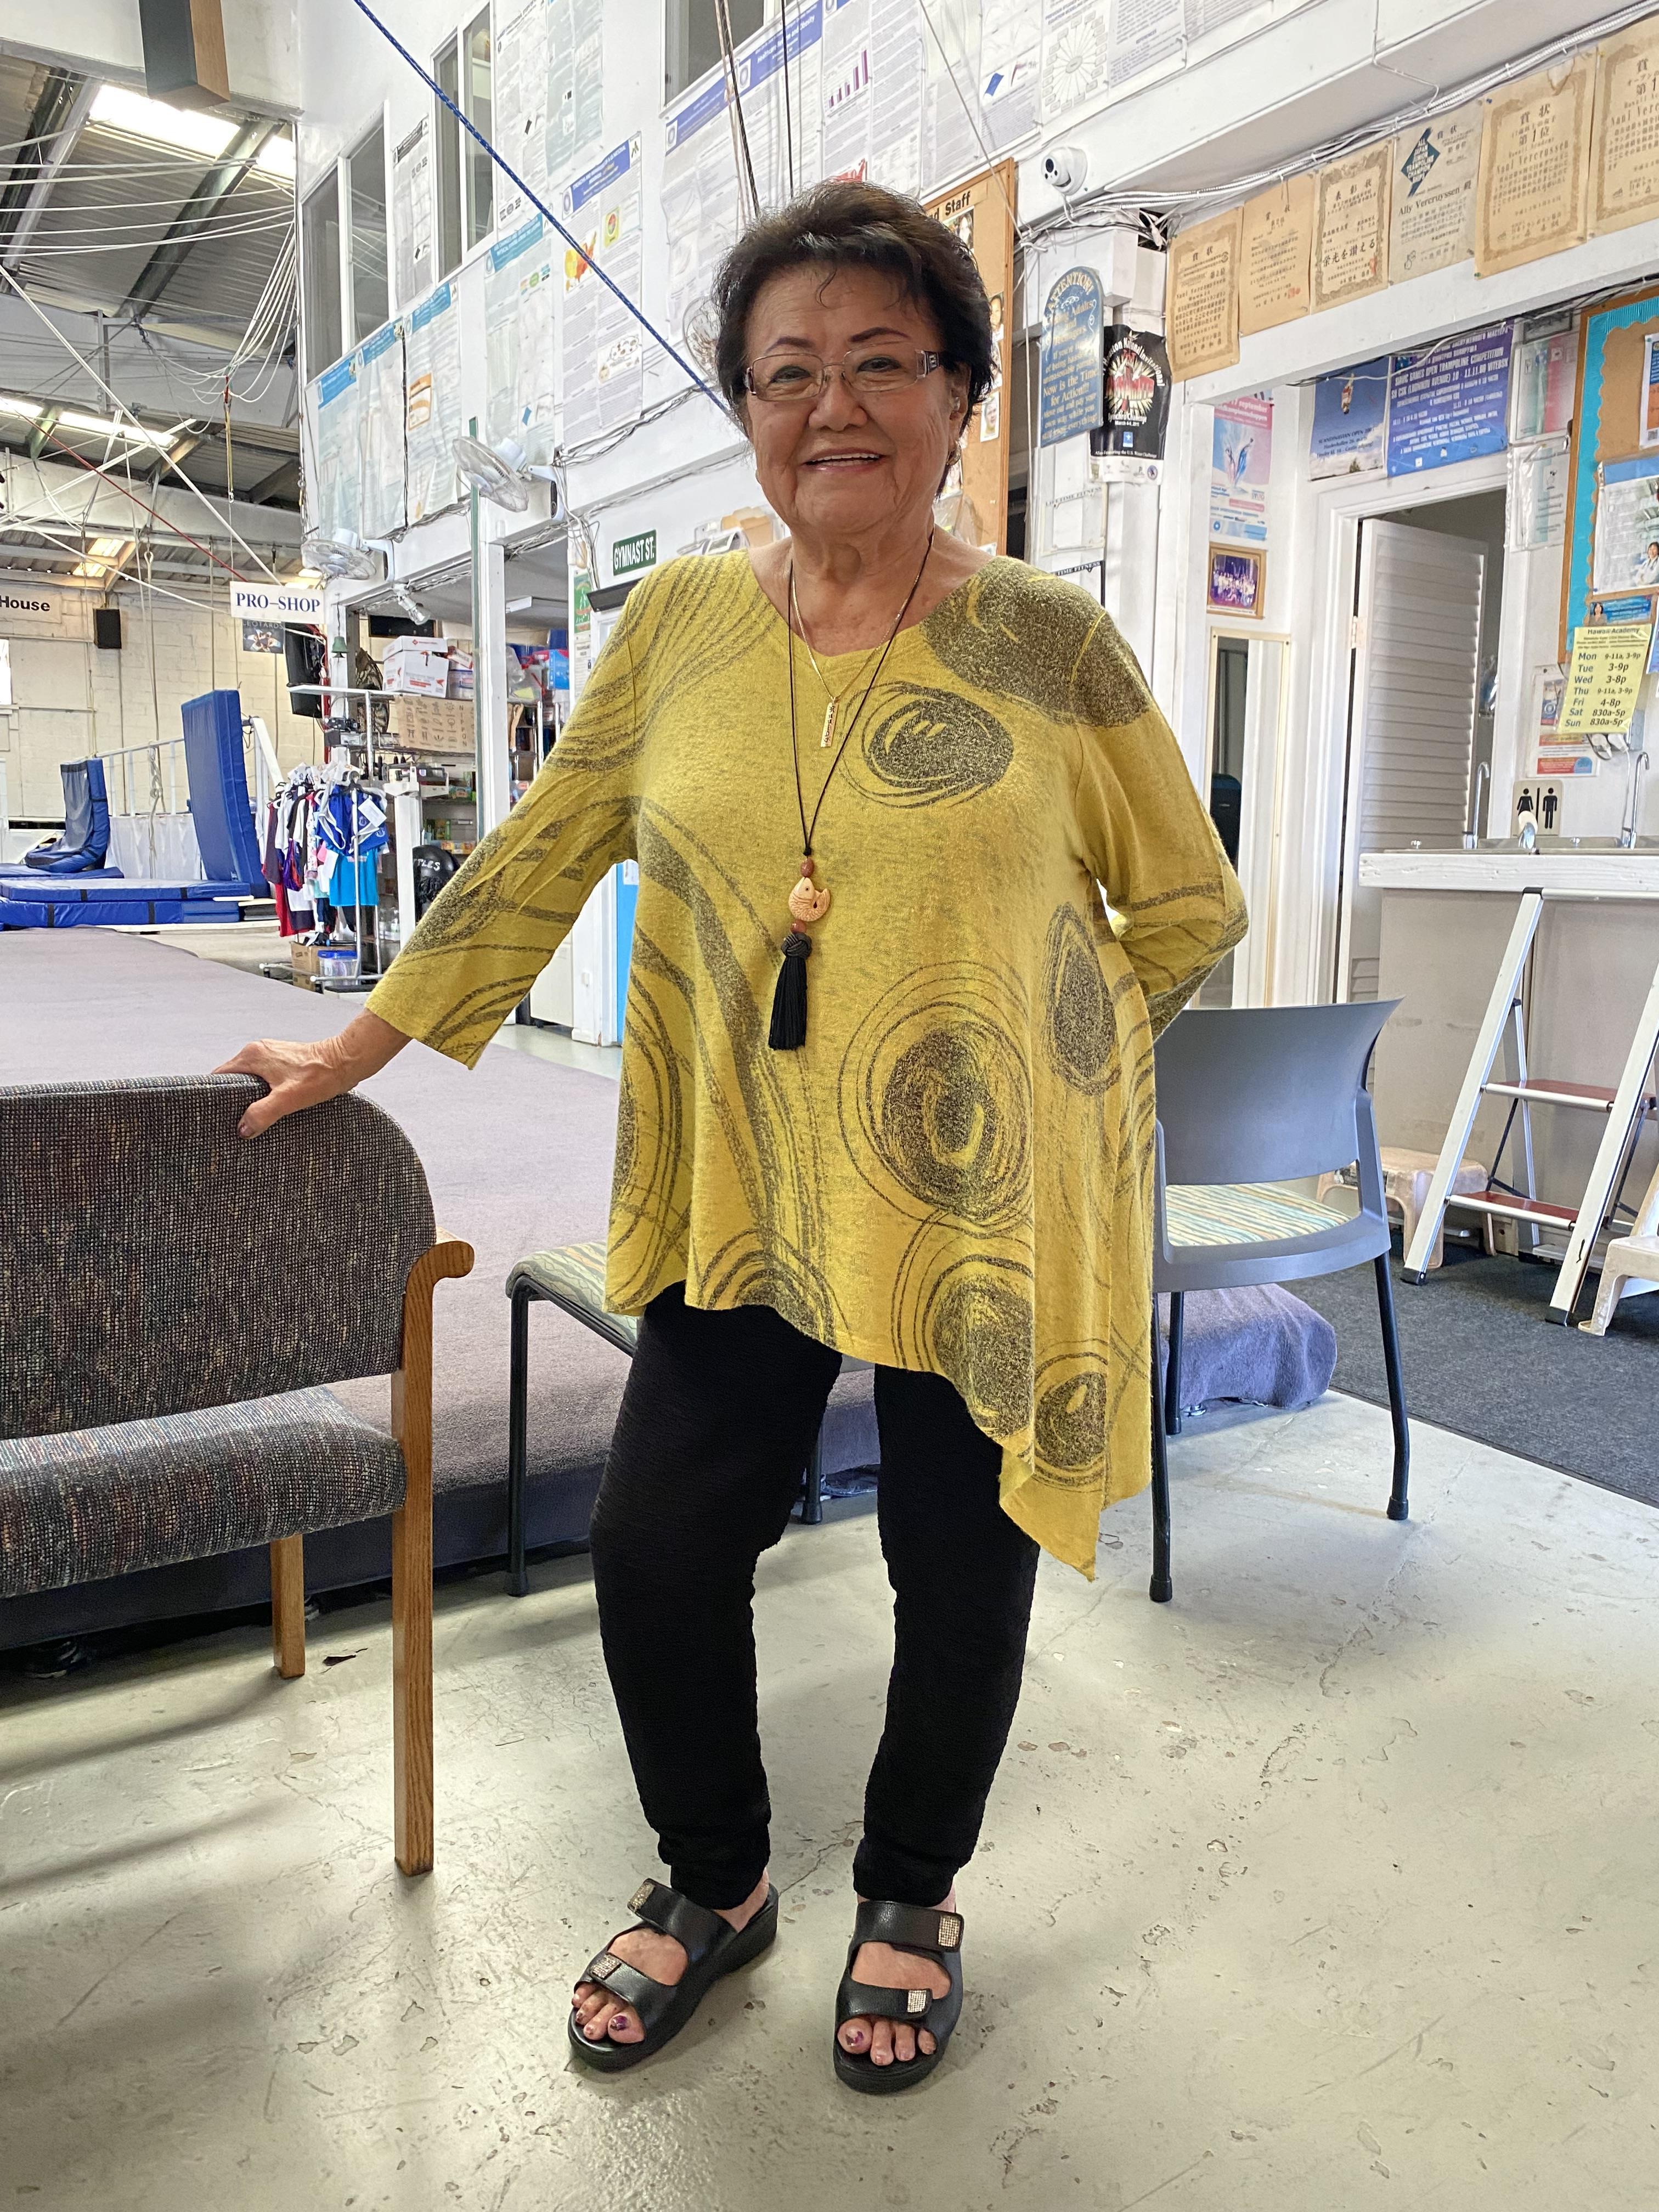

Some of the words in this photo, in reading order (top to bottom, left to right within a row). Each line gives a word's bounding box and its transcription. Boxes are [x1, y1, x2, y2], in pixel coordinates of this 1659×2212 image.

[945, 190, 970, 216] Staff
[1399, 205, 1413, 216] Ally
[1415, 187, 1460, 208] Vercruyssen
[1047, 272, 1093, 314] ATTENTION!
[1139, 348, 1165, 387] Invitational
[1409, 369, 1425, 381] GAMES
[1426, 365, 1438, 377] OPEN
[1440, 357, 1469, 373] TRAMPOLINE
[1471, 347, 1504, 364] COMPETITION
[1043, 385, 1057, 398] Now
[1067, 375, 1078, 388] the
[1080, 368, 1098, 382] Time
[1051, 395, 1060, 407] for
[1239, 401, 1267, 413] september
[1069, 408, 1084, 419] while
[1076, 487, 1102, 498] FITNESS
[614, 539, 645, 570] GYMNAST
[645, 536, 654, 561] ST.
[1057, 568, 1074, 576] TIME
[1075, 561, 1101, 572] FITNESS
[0, 595, 50, 611] House
[236, 592, 320, 612] PRO-SHOP
[1611, 627, 1640, 635] Academy
[1578, 664, 1594, 673] Tue
[1608, 663, 1629, 673] 3-9p
[1575, 675, 1593, 684] Wed
[1606, 675, 1626, 684] 3-8p
[1574, 687, 1589, 695] Thu
[1573, 698, 1584, 706] Fri
[1600, 698, 1621, 708] 4-8p
[1569, 708, 1583, 716] Sat
[1590, 718, 1623, 727] 830a-5p
